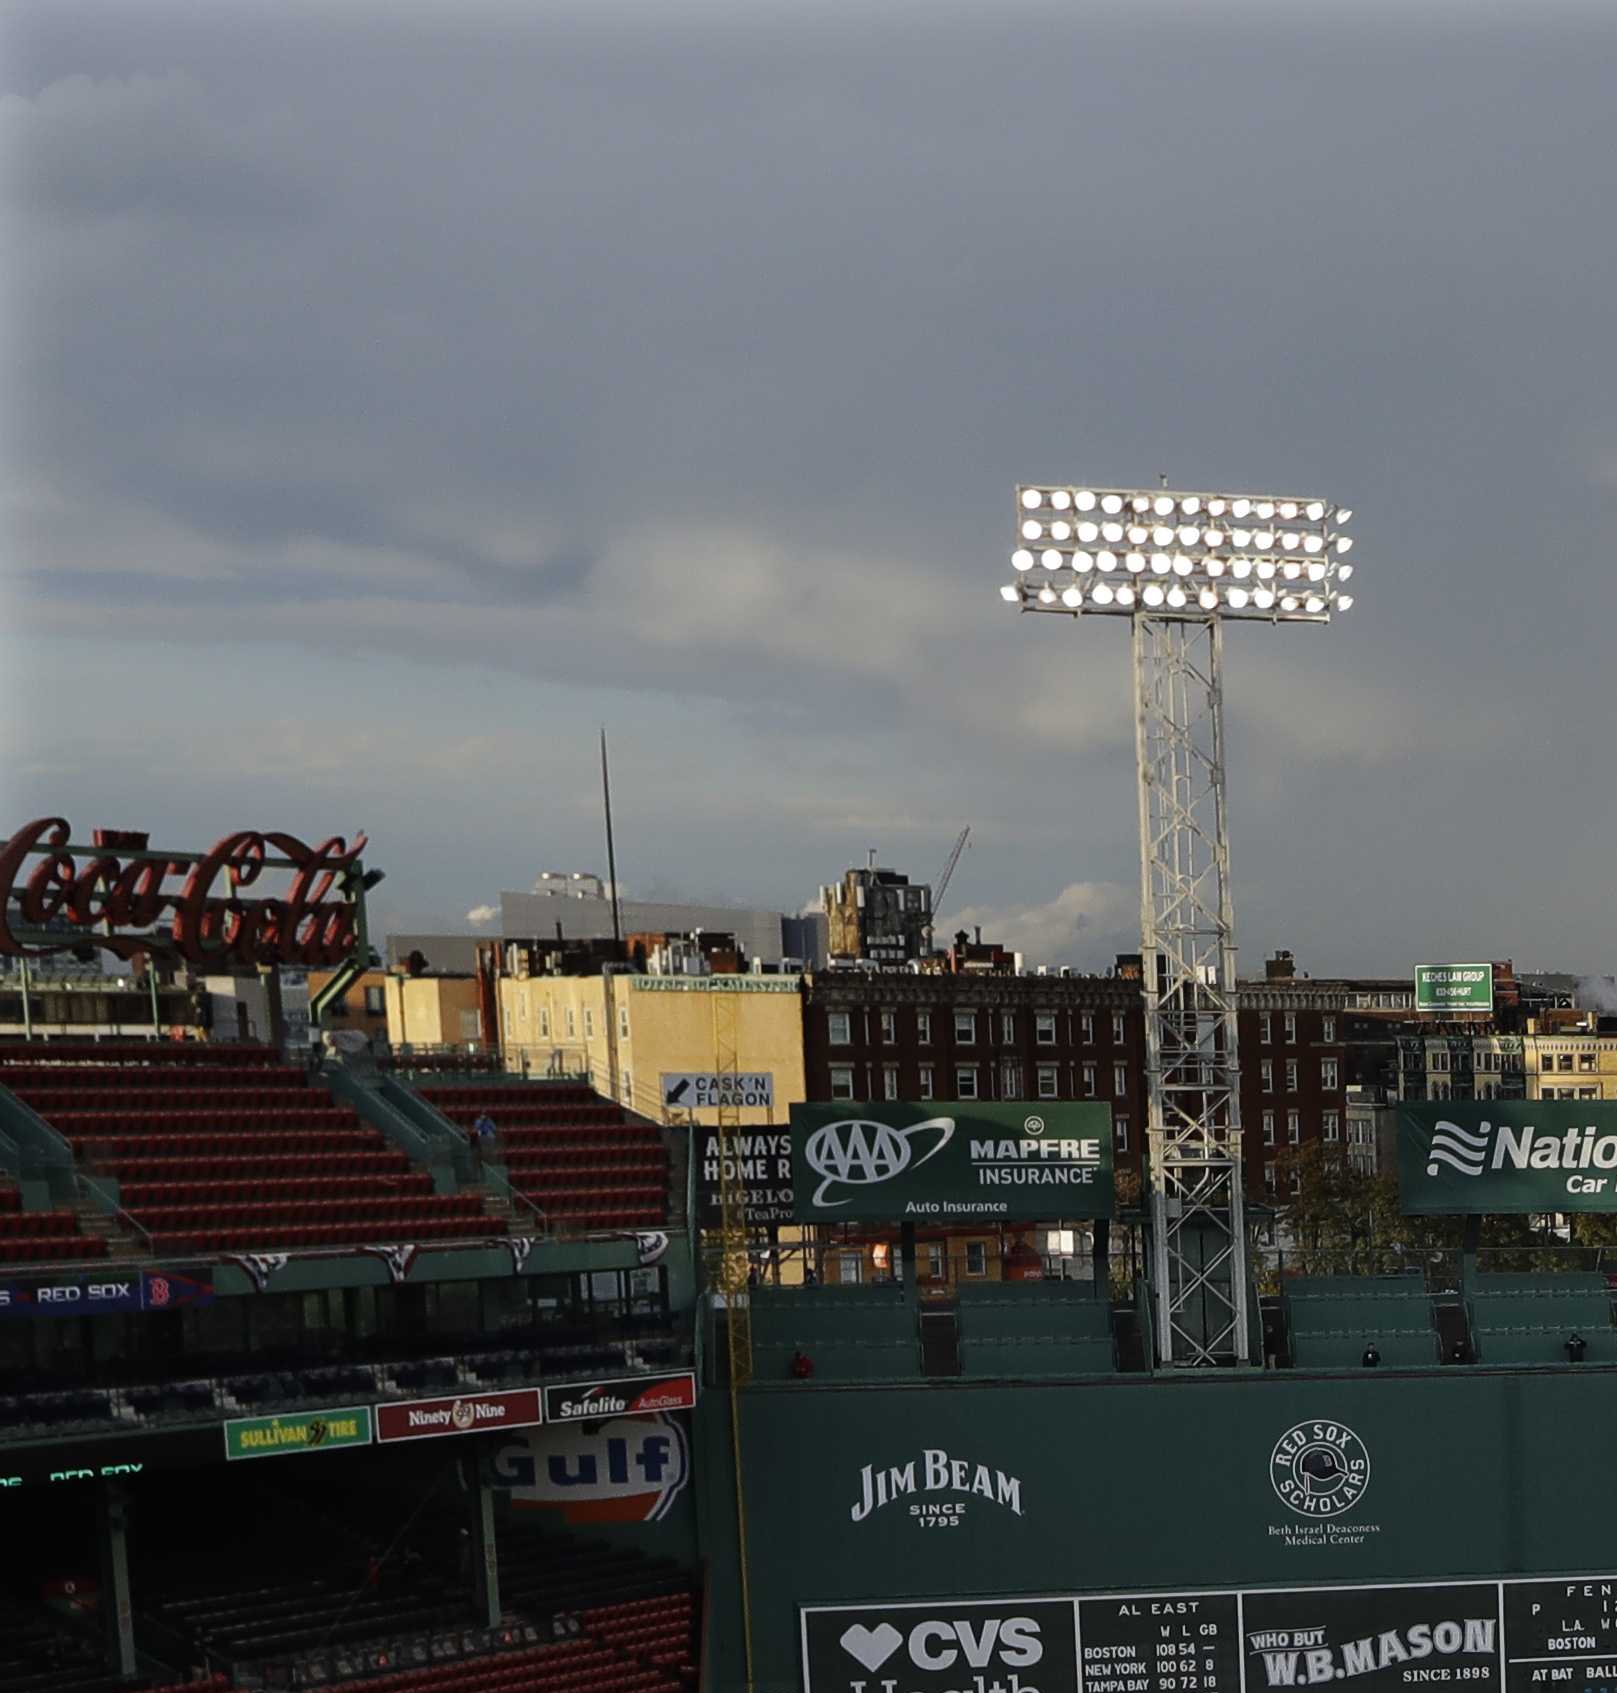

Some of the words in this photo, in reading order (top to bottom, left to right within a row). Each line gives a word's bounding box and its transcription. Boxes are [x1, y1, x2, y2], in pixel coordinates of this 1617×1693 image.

[695, 1077, 744, 1091] CASK
[697, 1093, 769, 1106] FLAGON
[706, 1135, 792, 1157] ALWAYS
[970, 1139, 1100, 1160] MAPFRE
[704, 1160, 768, 1181] HOME
[979, 1167, 1094, 1185] INSURANCE
[1566, 1175, 1607, 1193] Car
[905, 1200, 939, 1213] Auto
[943, 1200, 1008, 1213] Insurance
[37, 1286, 81, 1303] RED
[88, 1283, 130, 1300] SOX
[409, 1408, 450, 1426] Ninety
[476, 1403, 505, 1419] Nine
[559, 1396, 625, 1417] Safelite
[240, 1424, 306, 1448] SULLIVAN
[328, 1420, 358, 1438] TIRE
[1275, 1430, 1306, 1467] RED
[1313, 1424, 1352, 1449] SOX
[497, 1435, 670, 1486] Gulf
[851, 1461, 917, 1522] JIM
[922, 1449, 1022, 1517] BEAM
[1280, 1459, 1364, 1512] SCHOLARS
[909, 1503, 966, 1515] SINCE
[918, 1516, 960, 1528] 1795
[1268, 1525, 1291, 1536] Beth
[1295, 1524, 1323, 1534] Israel
[1327, 1523, 1381, 1533] Deaconess
[1285, 1535, 1327, 1546] Medical
[1330, 1534, 1365, 1544] Center
[1119, 1604, 1141, 1616] AL
[1151, 1602, 1199, 1614] EAST
[1532, 1604, 1541, 1615] P
[1160, 1625, 1170, 1637] W
[1182, 1625, 1191, 1636] L
[1200, 1624, 1217, 1635] GB
[1562, 1619, 1585, 1632] L.A.
[908, 1617, 1043, 1671] CVS
[1250, 1632, 1289, 1650] WHO
[1293, 1630, 1325, 1647] BUT
[1548, 1636, 1596, 1650] BOSTON
[1084, 1646, 1136, 1659] BOSTON
[1156, 1644, 1176, 1656] 108
[1178, 1643, 1195, 1656] 54
[1085, 1664, 1111, 1676] NEW
[1114, 1662, 1146, 1675] YORK
[1157, 1660, 1177, 1673] 100
[1179, 1660, 1196, 1672] 62
[1205, 1659, 1214, 1670] 8
[1403, 1668, 1451, 1683] SINCE
[1455, 1667, 1490, 1680] 1898
[1531, 1669, 1548, 1682] AT
[1551, 1668, 1574, 1680] BAT
[1086, 1680, 1125, 1693] TAMPA
[1127, 1679, 1149, 1691] BAY
[1159, 1678, 1176, 1690] 90
[1180, 1677, 1197, 1689] 72
[1203, 1676, 1216, 1687] 18
